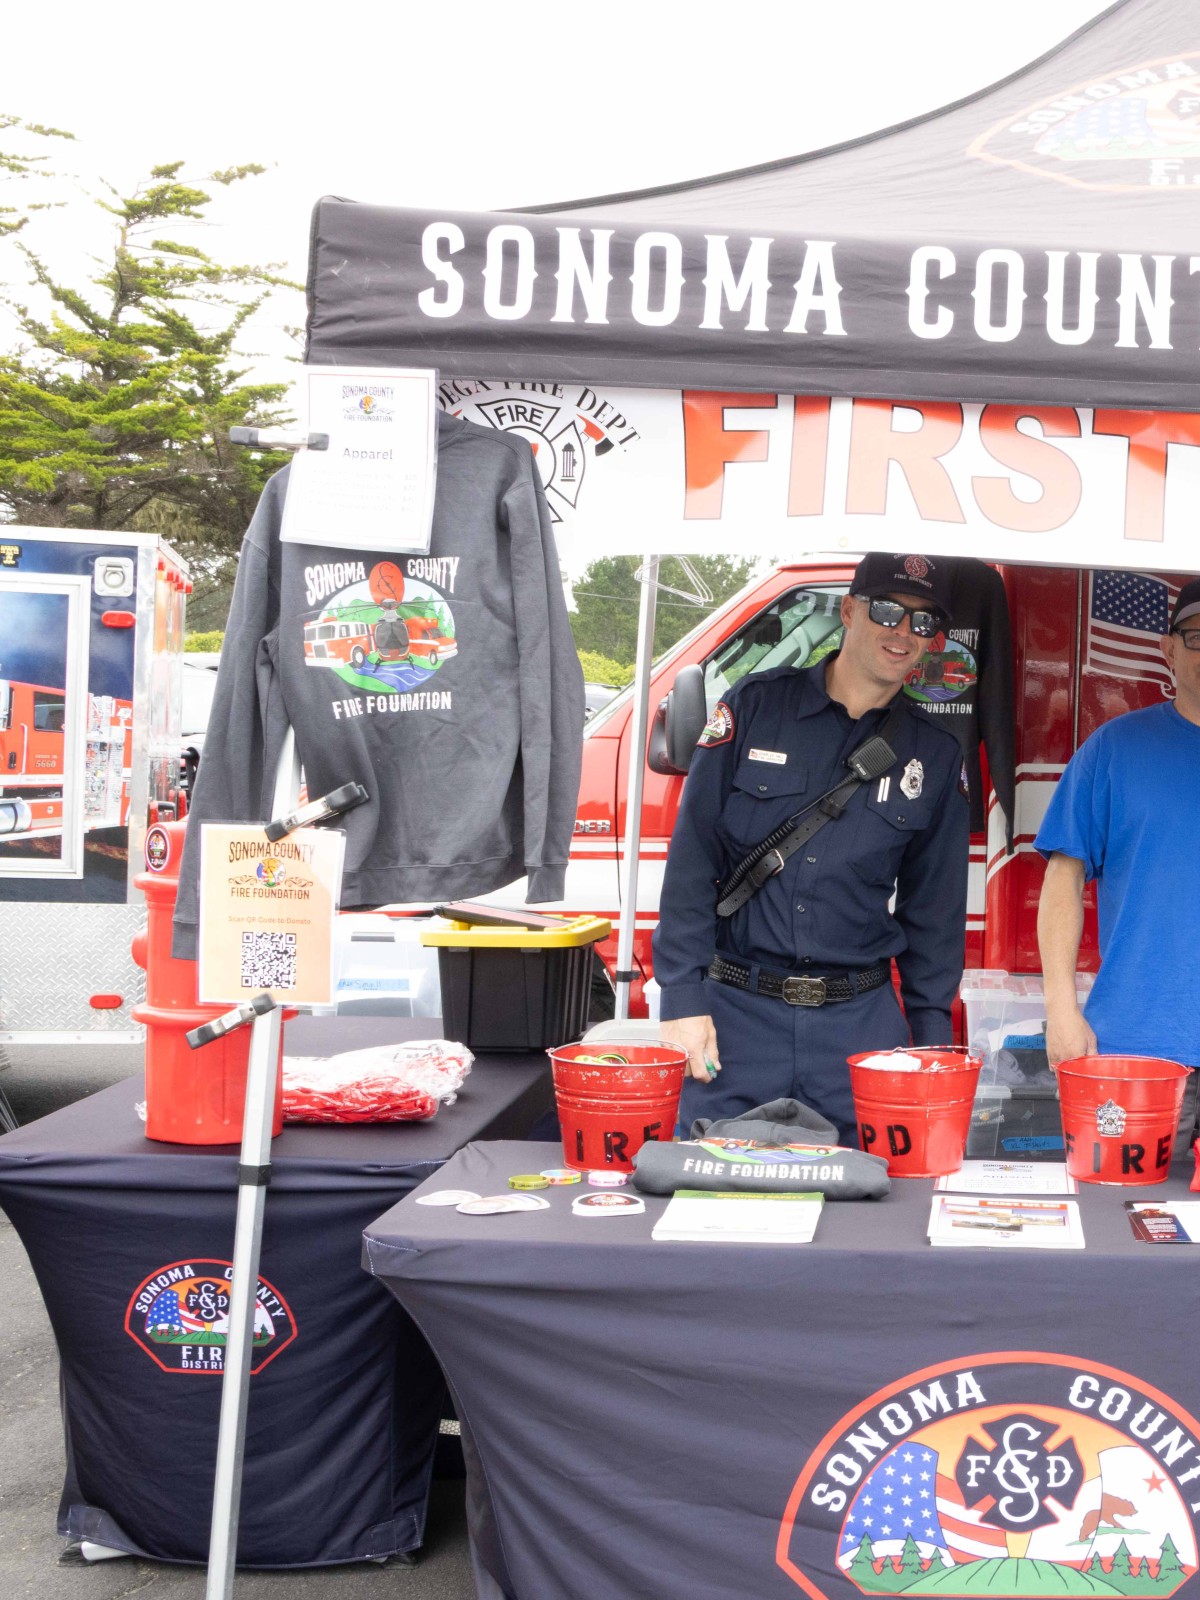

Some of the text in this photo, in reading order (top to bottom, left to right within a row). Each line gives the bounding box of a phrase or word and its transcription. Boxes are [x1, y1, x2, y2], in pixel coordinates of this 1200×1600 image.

[1009, 62, 1200, 136] SONOMA
[418, 221, 848, 336] SONOMA
[342, 385, 394, 400] SONOMA COUNTY
[494, 405, 544, 427] FIRE
[576, 387, 640, 452] DEPT.
[343, 448, 393, 460] Apparel
[304, 557, 460, 606] SONOMA COUNTY
[949, 629, 980, 650] COUNTY
[332, 691, 452, 719] FIRE FOUNDATION
[917, 703, 972, 714] OUNDATION
[721, 706, 732, 729] COUNTY
[229, 841, 316, 864] SONOMA COUNTY
[231, 887, 310, 900] FIRE FOUNDATION
[247, 916, 257, 924] QR
[286, 917, 312, 925] Donate
[1065, 1132, 1172, 1175] FIRE
[682, 1158, 844, 1181] FIRE FOUNDATION
[135, 1265, 196, 1314] SONOMA
[182, 1345, 223, 1361] FIR
[182, 1361, 225, 1370] DISTRI
[811, 1371, 987, 1513] SONOMA
